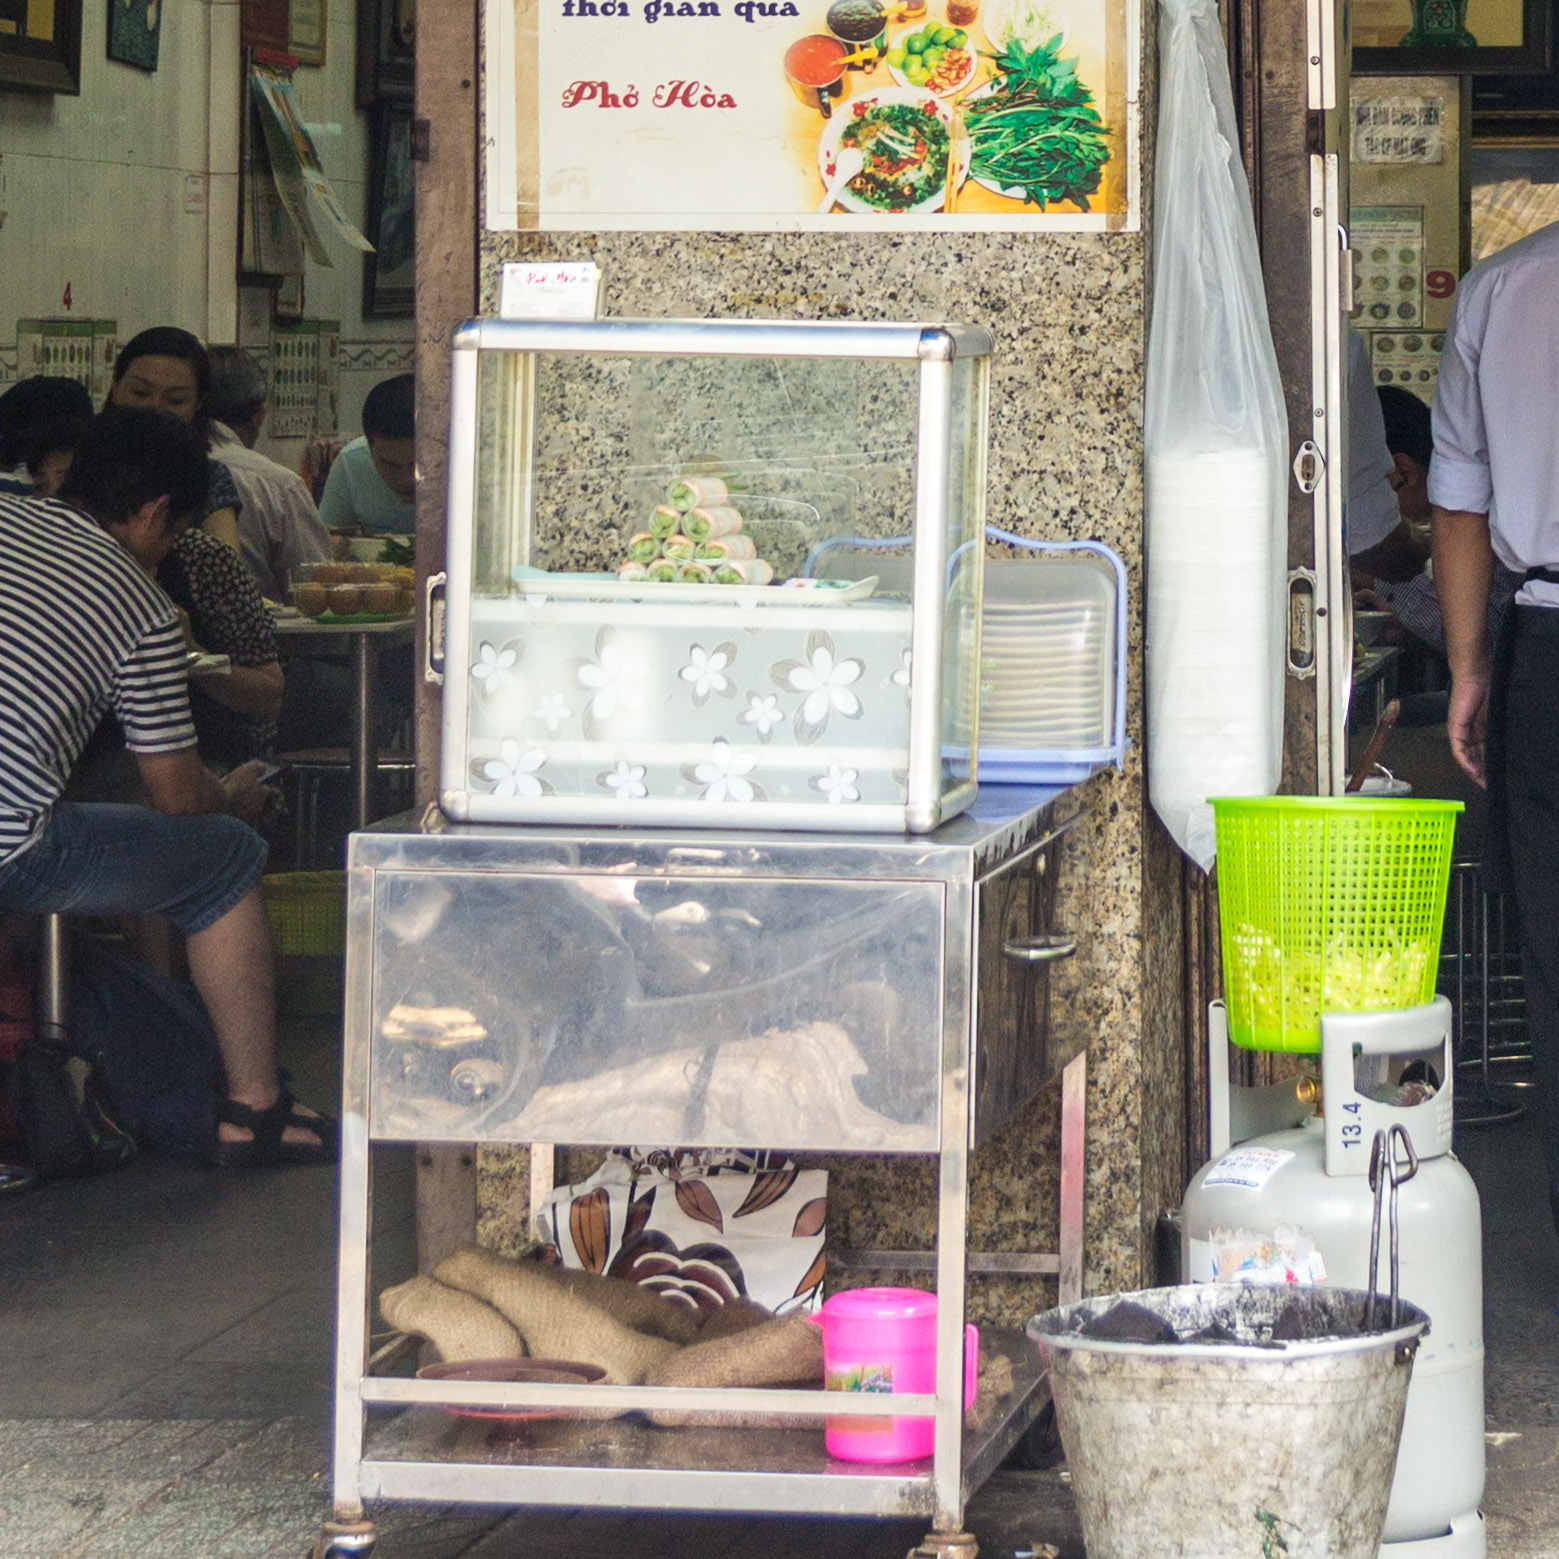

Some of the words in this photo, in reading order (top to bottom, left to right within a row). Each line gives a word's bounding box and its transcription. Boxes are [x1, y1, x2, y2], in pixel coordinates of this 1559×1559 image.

[734, 1, 799, 23] qua
[562, 81, 639, 108] Phở
[652, 80, 737, 108] Hòa
[62, 281, 73, 311] 4
[1426, 270, 1456, 298] 9
[1342, 1102, 1361, 1148] 13.4
